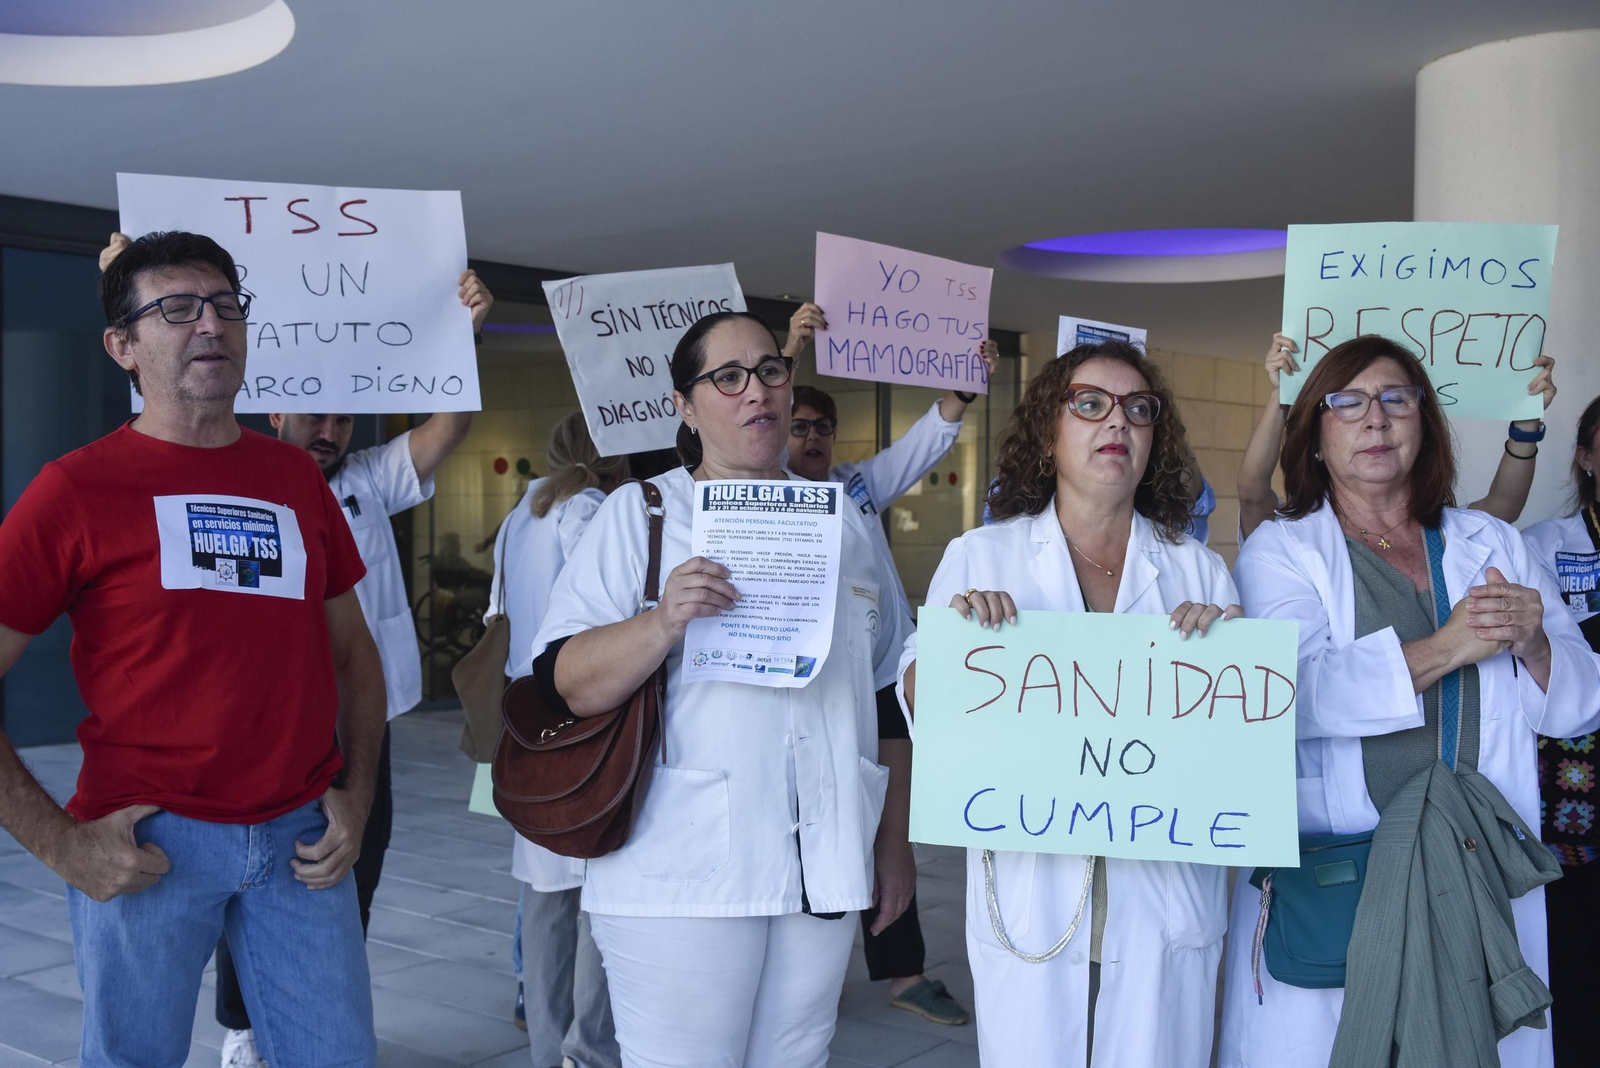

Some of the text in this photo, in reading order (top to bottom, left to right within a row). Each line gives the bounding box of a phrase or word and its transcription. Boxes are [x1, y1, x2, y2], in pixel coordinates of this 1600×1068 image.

[224, 196, 378, 236] TSS
[301, 261, 369, 297] UN
[879, 260, 920, 293] YO
[848, 301, 984, 340] HAGO TUS
[246, 321, 413, 349] ATUTO
[1303, 306, 1546, 371] RESPETO
[625, 356, 655, 378] NO
[709, 485, 829, 504] HUELGA TSS
[190, 504, 273, 522] Técnicos Superiores Sanitarios
[192, 519, 203, 529] en
[204, 519, 241, 531] servicios
[777, 519, 818, 527] FACULTATIVO
[193, 532, 278, 560] HUELGA TSS
[1564, 564, 1593, 574] servicios
[1561, 574, 1596, 593] UELGA
[748, 633, 776, 641] NUESTRO
[750, 624, 779, 632] NUESTRO
[1079, 736, 1156, 777] NO
[963, 787, 1251, 848] CUMPLE
